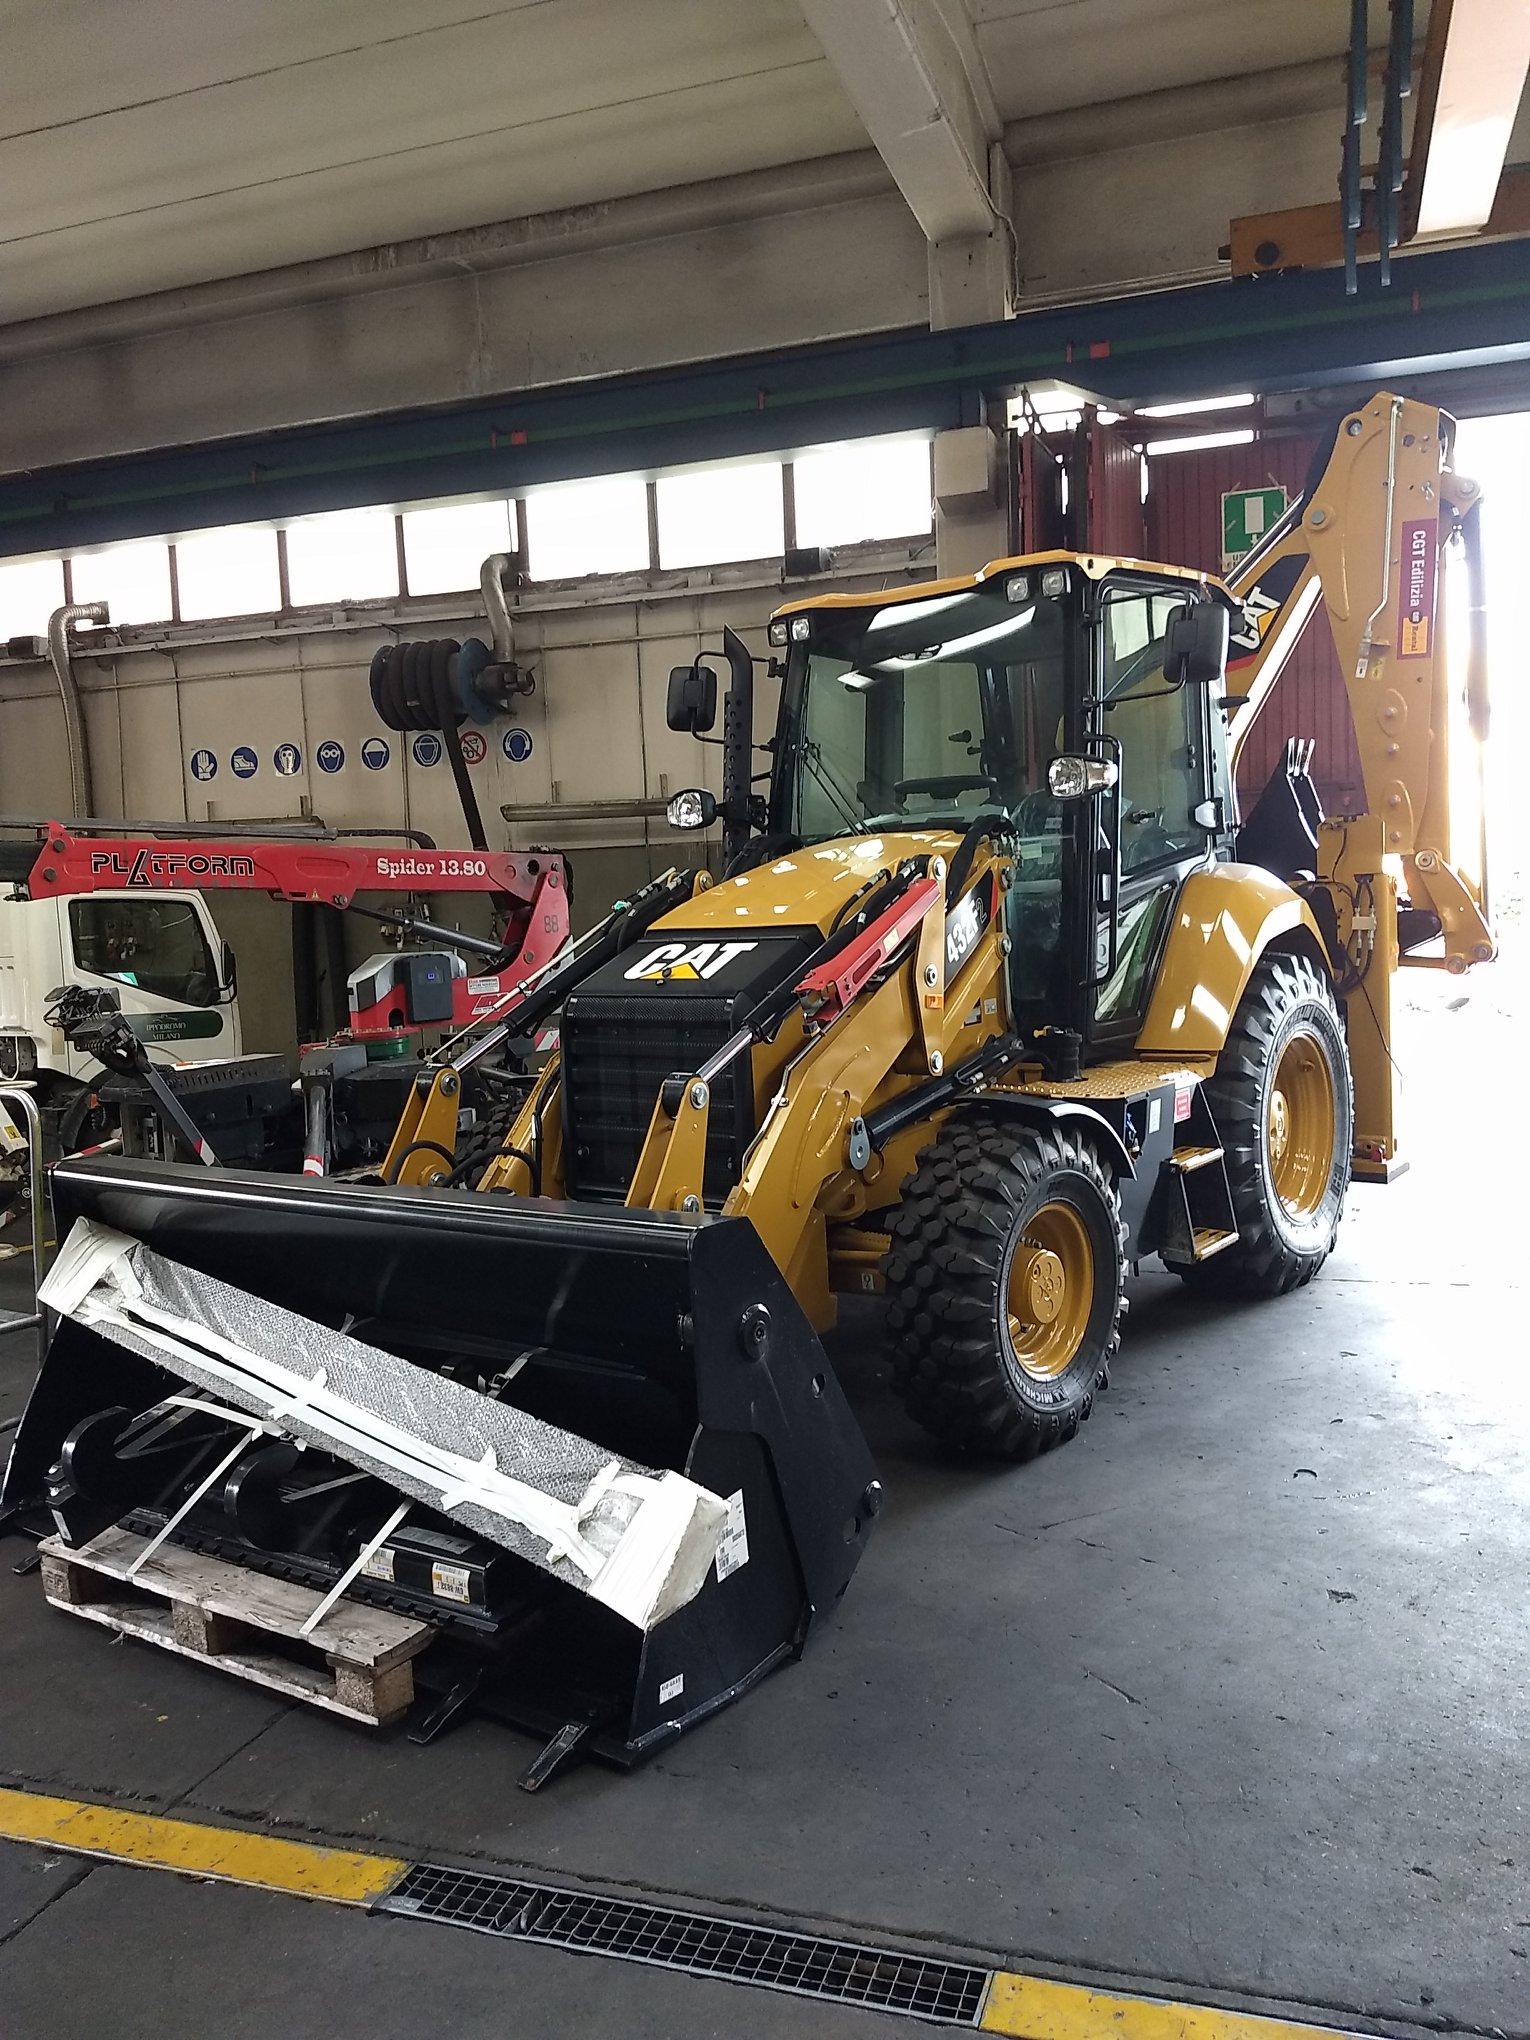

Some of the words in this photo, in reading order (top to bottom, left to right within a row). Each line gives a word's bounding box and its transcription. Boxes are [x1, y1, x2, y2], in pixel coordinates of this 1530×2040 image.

[1411, 530, 1426, 557] CGT
[1410, 559, 1425, 607] Edilizia
[1230, 585, 1281, 650] CAT
[376, 857, 435, 879] Spider
[439, 860, 486, 876] 13.80
[543, 915, 559, 934] 88
[623, 941, 760, 981] CAT
[146, 1022, 187, 1031] IPPODROMO
[1015, 1372, 1054, 1404] MICHELIN
